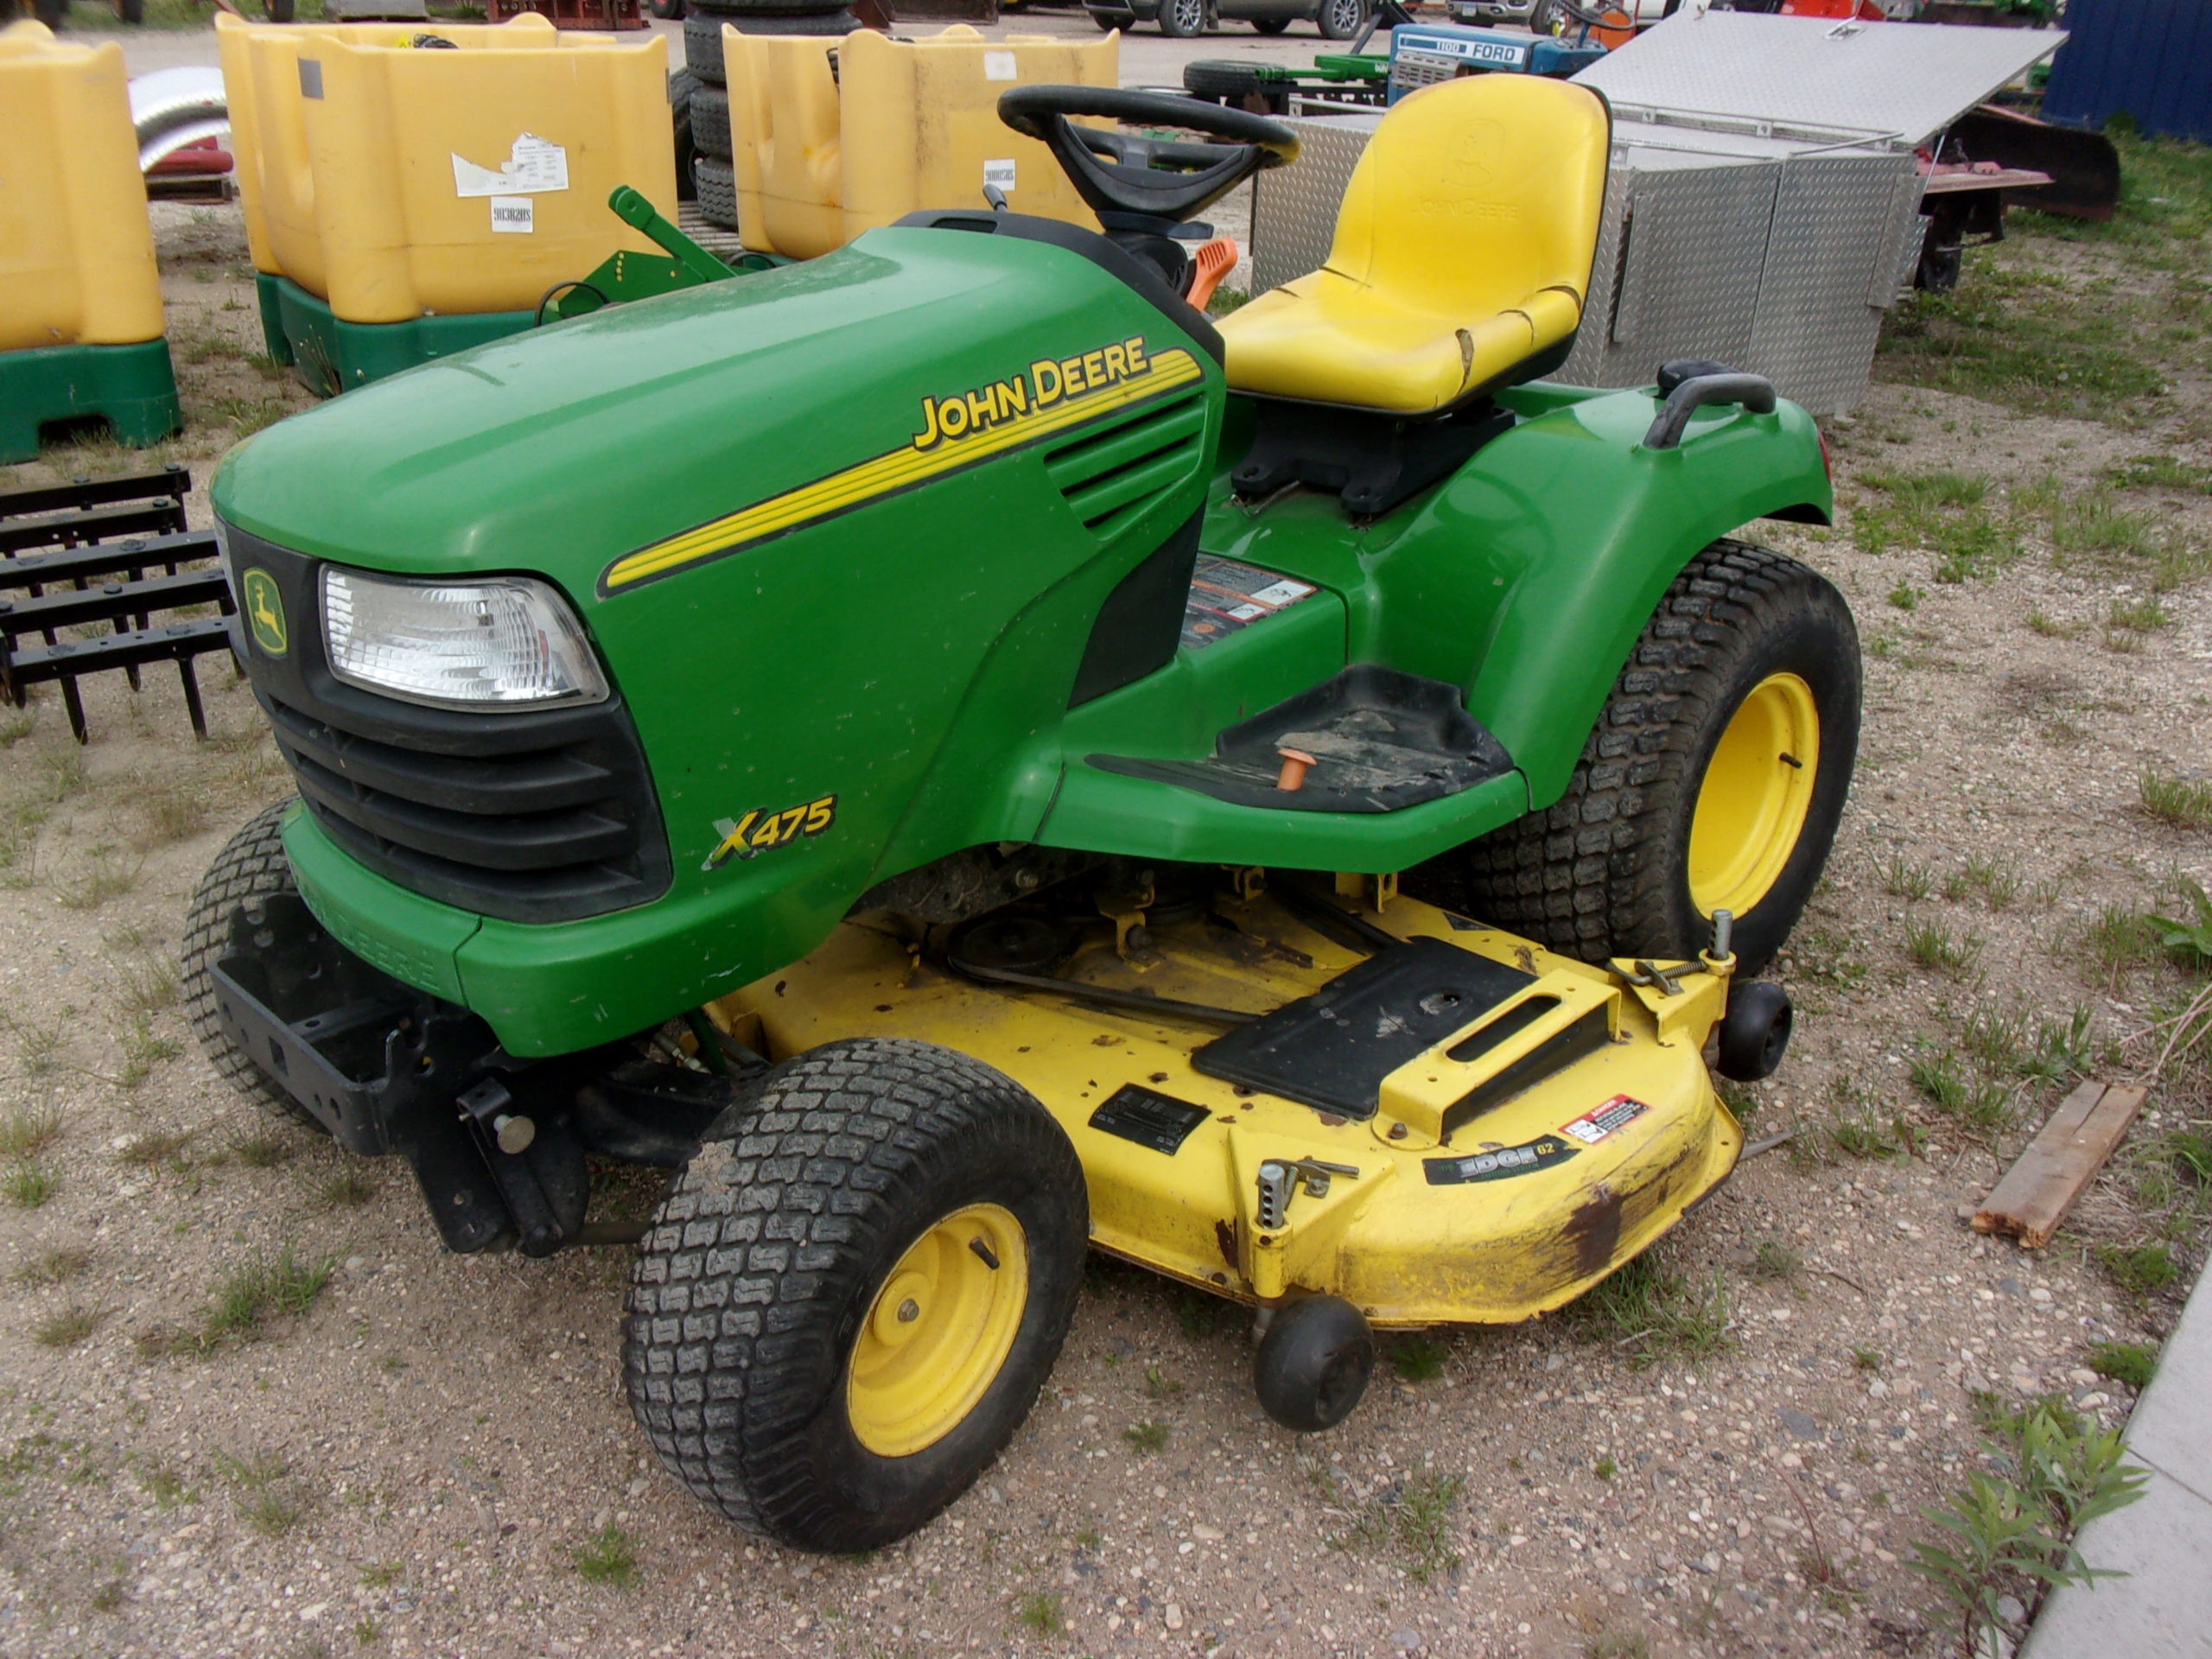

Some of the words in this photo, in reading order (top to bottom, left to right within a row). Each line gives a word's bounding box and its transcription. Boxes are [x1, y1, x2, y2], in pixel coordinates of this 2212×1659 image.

[1472, 43, 1516, 61] FORD
[912, 375, 1028, 449] JOHN
[1030, 336, 1148, 408] DEERE
[702, 795, 837, 870] X475
[1456, 1146, 1538, 1179] EDGE
